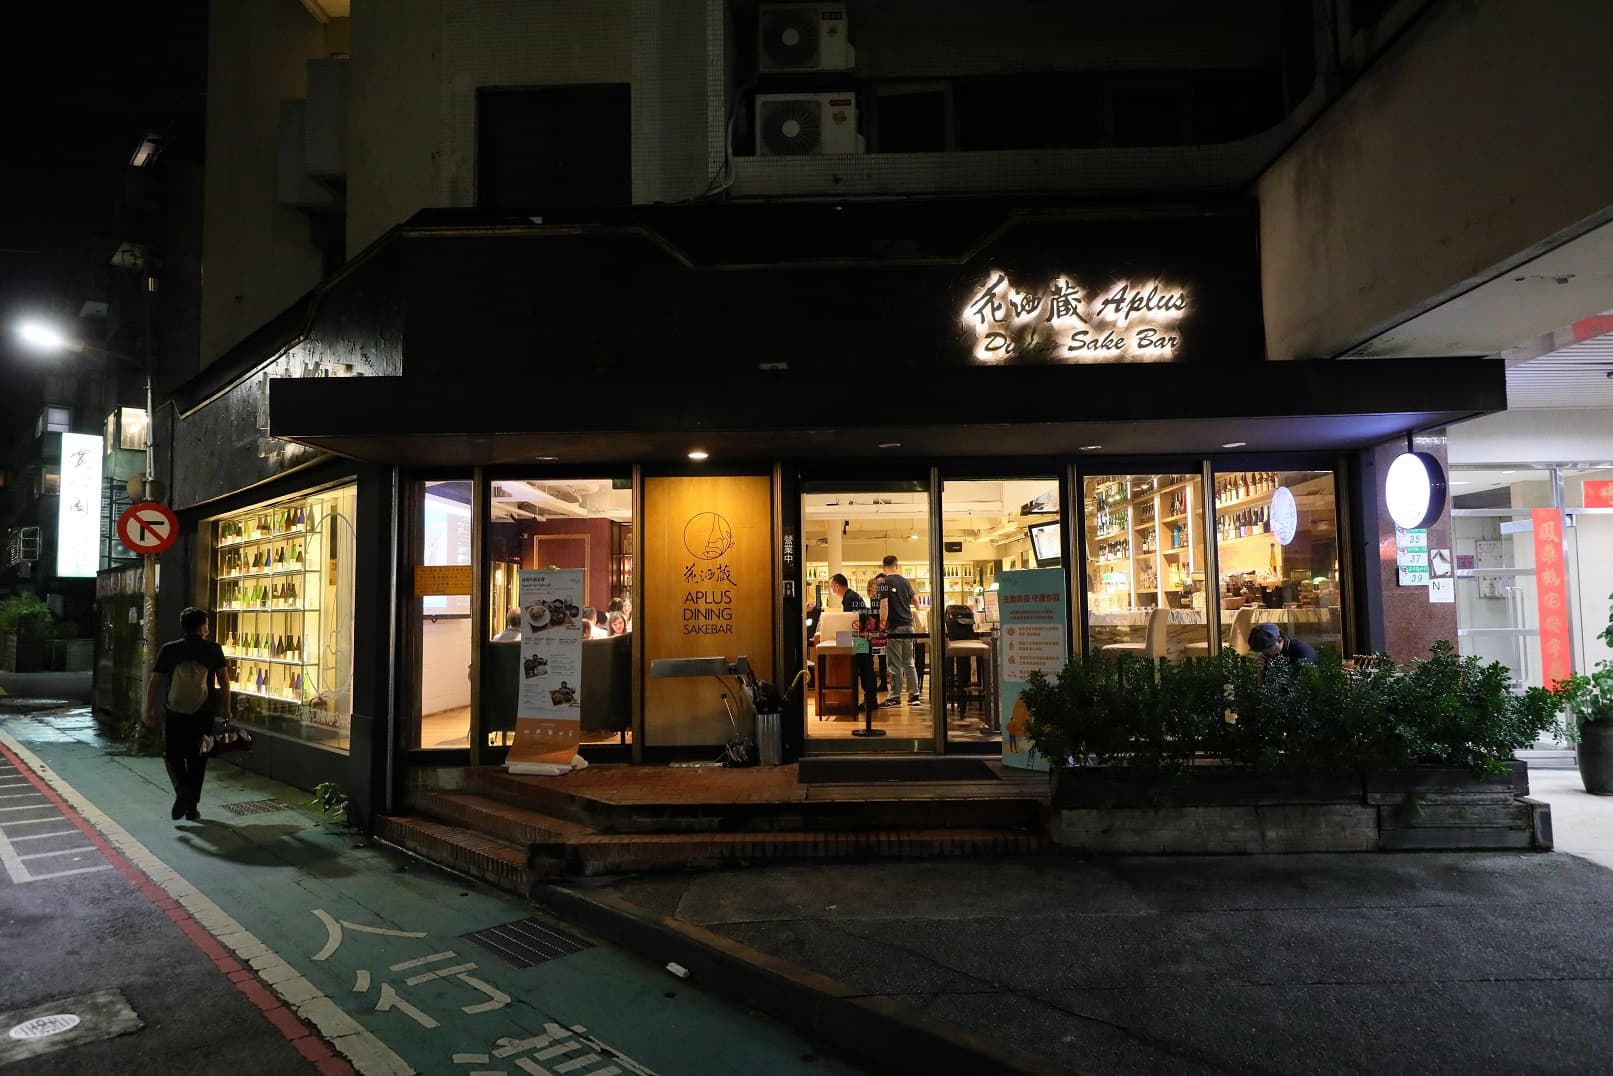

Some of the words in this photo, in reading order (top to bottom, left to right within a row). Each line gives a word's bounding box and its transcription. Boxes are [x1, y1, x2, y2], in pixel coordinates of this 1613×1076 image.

[1096, 284, 1187, 320] Aplus
[1067, 330, 1126, 352] Sake
[1136, 328, 1179, 349] Bar
[1409, 535, 1421, 544] 35
[1410, 554, 1421, 563] 37
[1411, 574, 1423, 583] 39
[683, 590, 733, 605] APLUS
[683, 607, 733, 621] DINING
[683, 624, 733, 635] SAKEBAR
